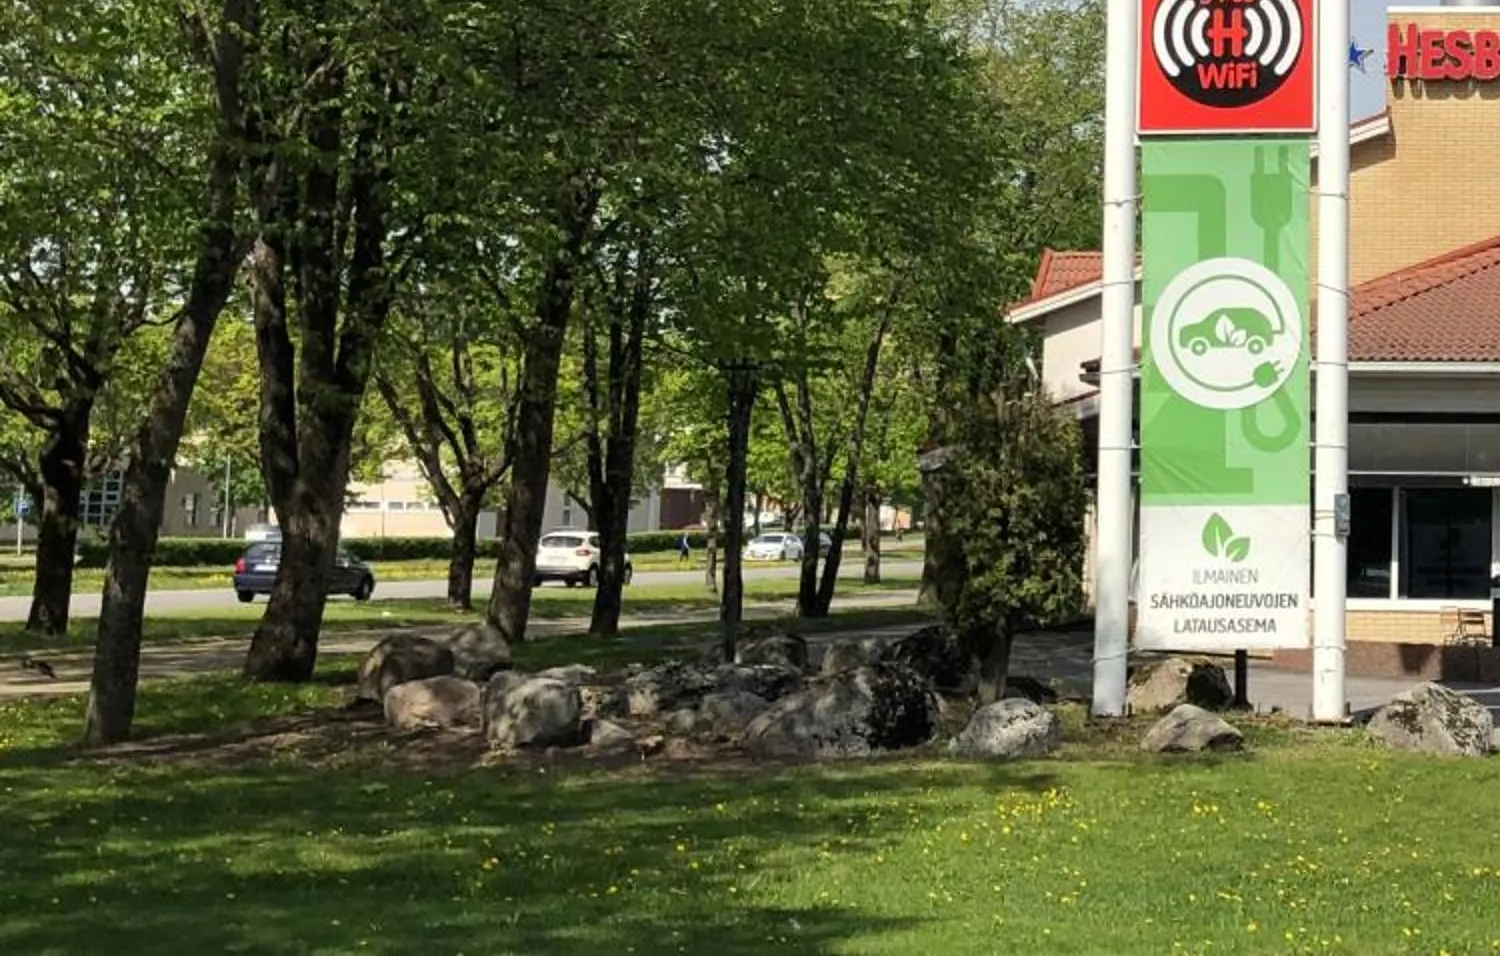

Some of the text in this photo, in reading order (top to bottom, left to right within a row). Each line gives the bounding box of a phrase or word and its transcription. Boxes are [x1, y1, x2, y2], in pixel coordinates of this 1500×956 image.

[1196, 62, 1260, 91] WiFi
[1192, 568, 1260, 585] ILMAINEN
[1150, 591, 1300, 609] SÄHKÖAJONEUVOJEN
[1173, 617, 1278, 634] LATAUSASEMA
